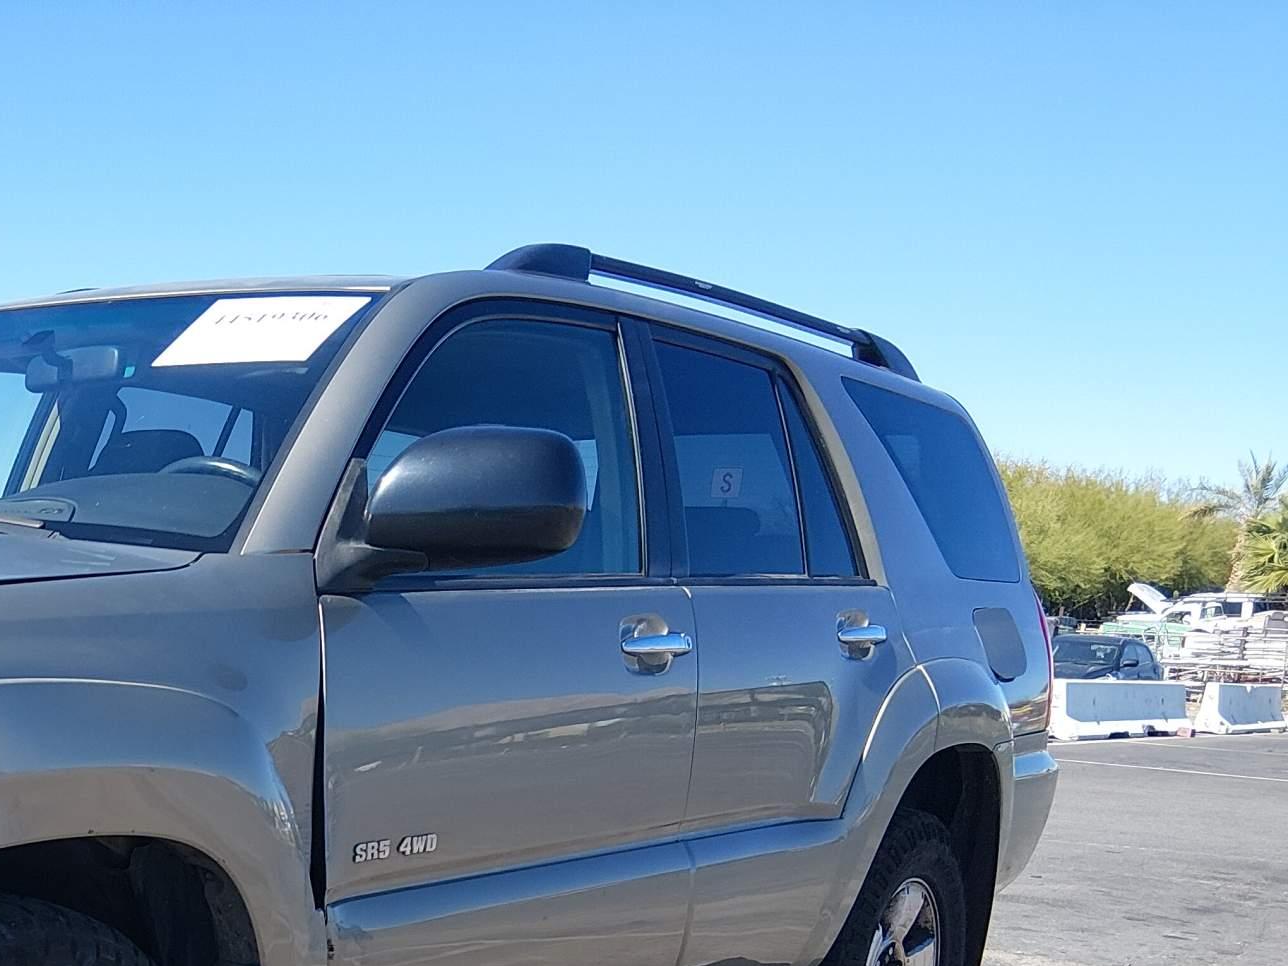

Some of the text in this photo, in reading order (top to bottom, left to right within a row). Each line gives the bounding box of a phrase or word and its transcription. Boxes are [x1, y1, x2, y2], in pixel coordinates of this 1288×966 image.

[720, 472, 733, 493] S
[353, 833, 437, 864] SR5 4WD
